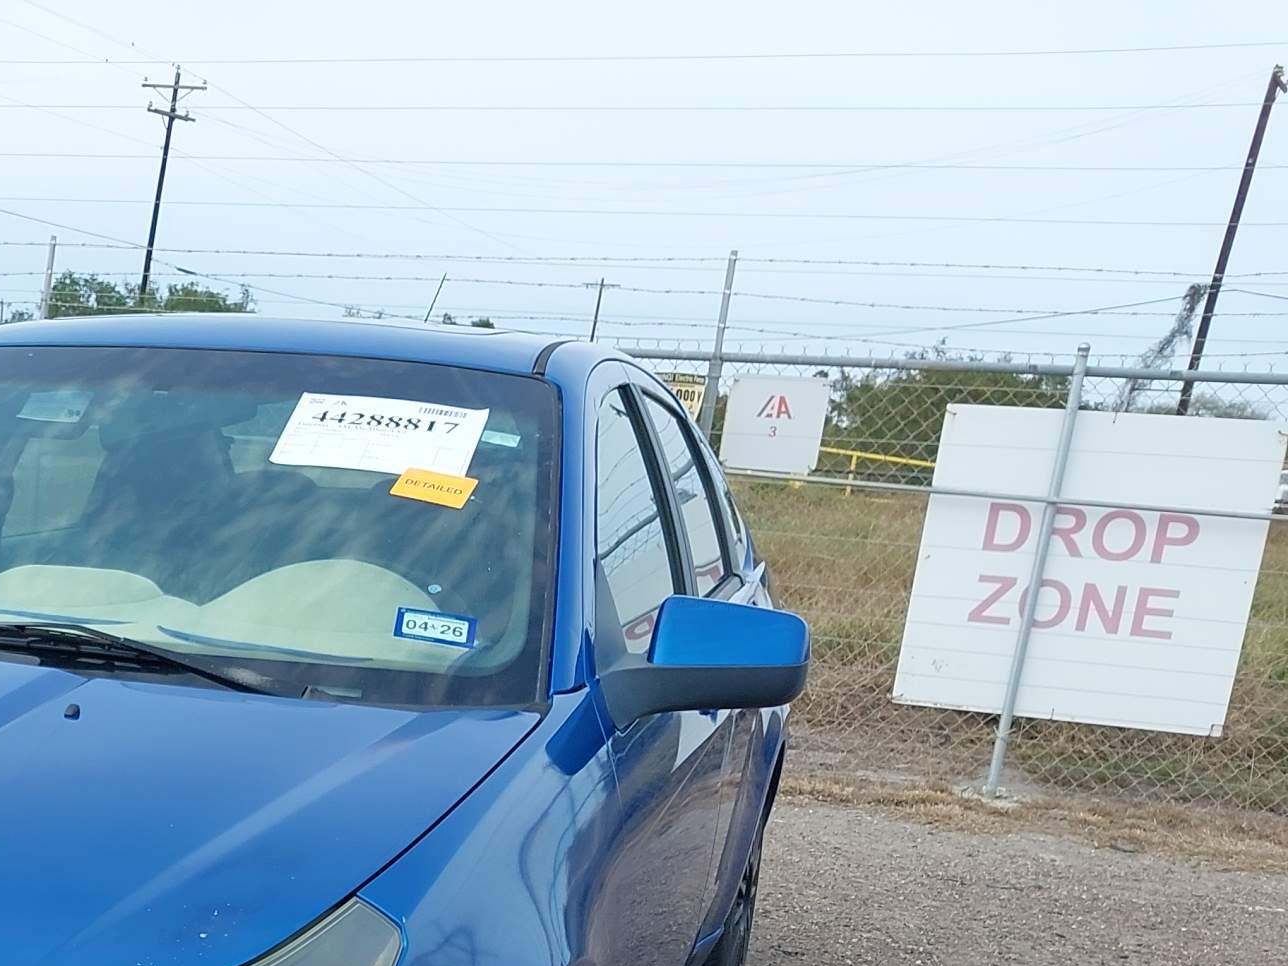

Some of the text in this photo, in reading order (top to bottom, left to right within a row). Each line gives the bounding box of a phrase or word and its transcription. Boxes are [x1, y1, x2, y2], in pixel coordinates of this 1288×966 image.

[312, 410, 460, 434] 44288817
[768, 425, 777, 438] 3
[405, 478, 463, 495] DETAILED
[982, 502, 1200, 563] DROP
[967, 574, 1181, 640] ZONE
